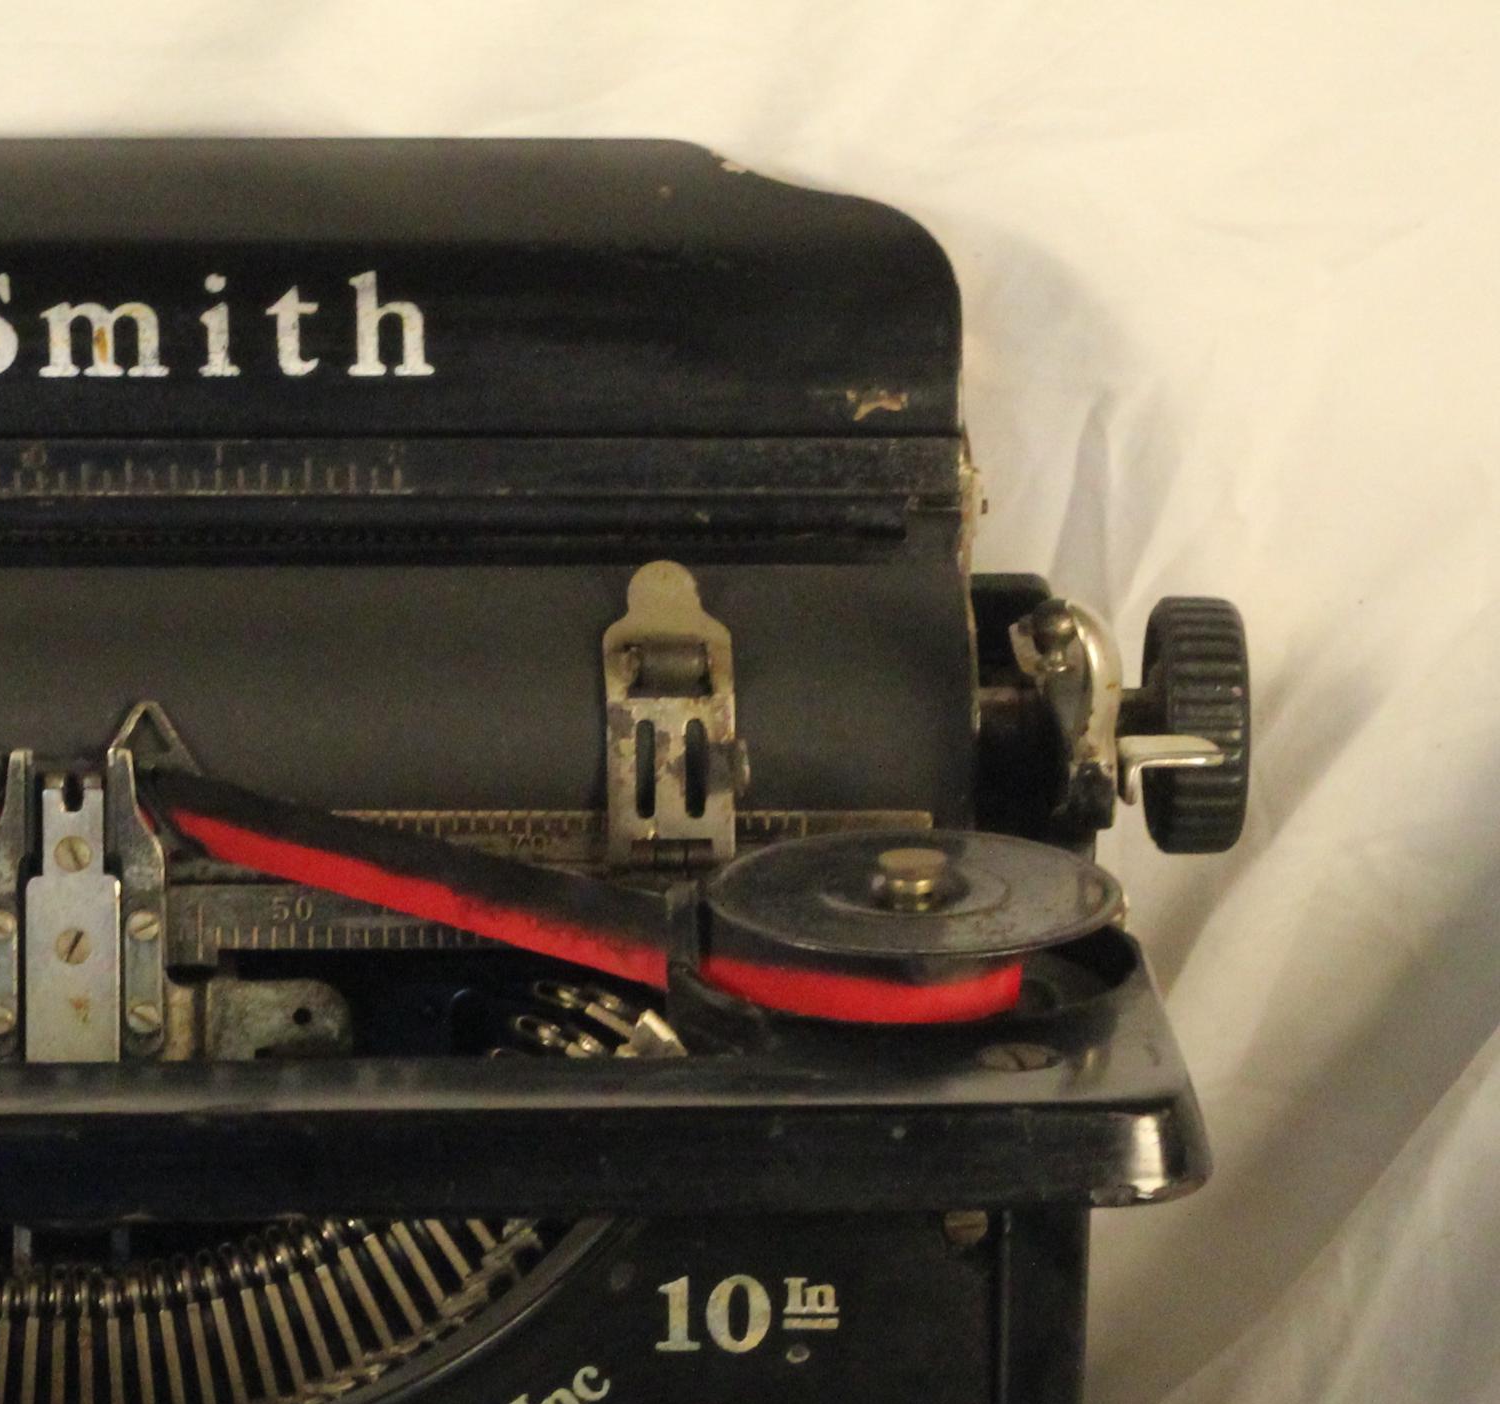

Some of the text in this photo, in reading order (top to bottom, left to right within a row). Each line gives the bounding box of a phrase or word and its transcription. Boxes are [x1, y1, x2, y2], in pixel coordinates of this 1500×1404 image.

[271, 897, 313, 922] 50
[655, 1274, 840, 1354] 10 In
